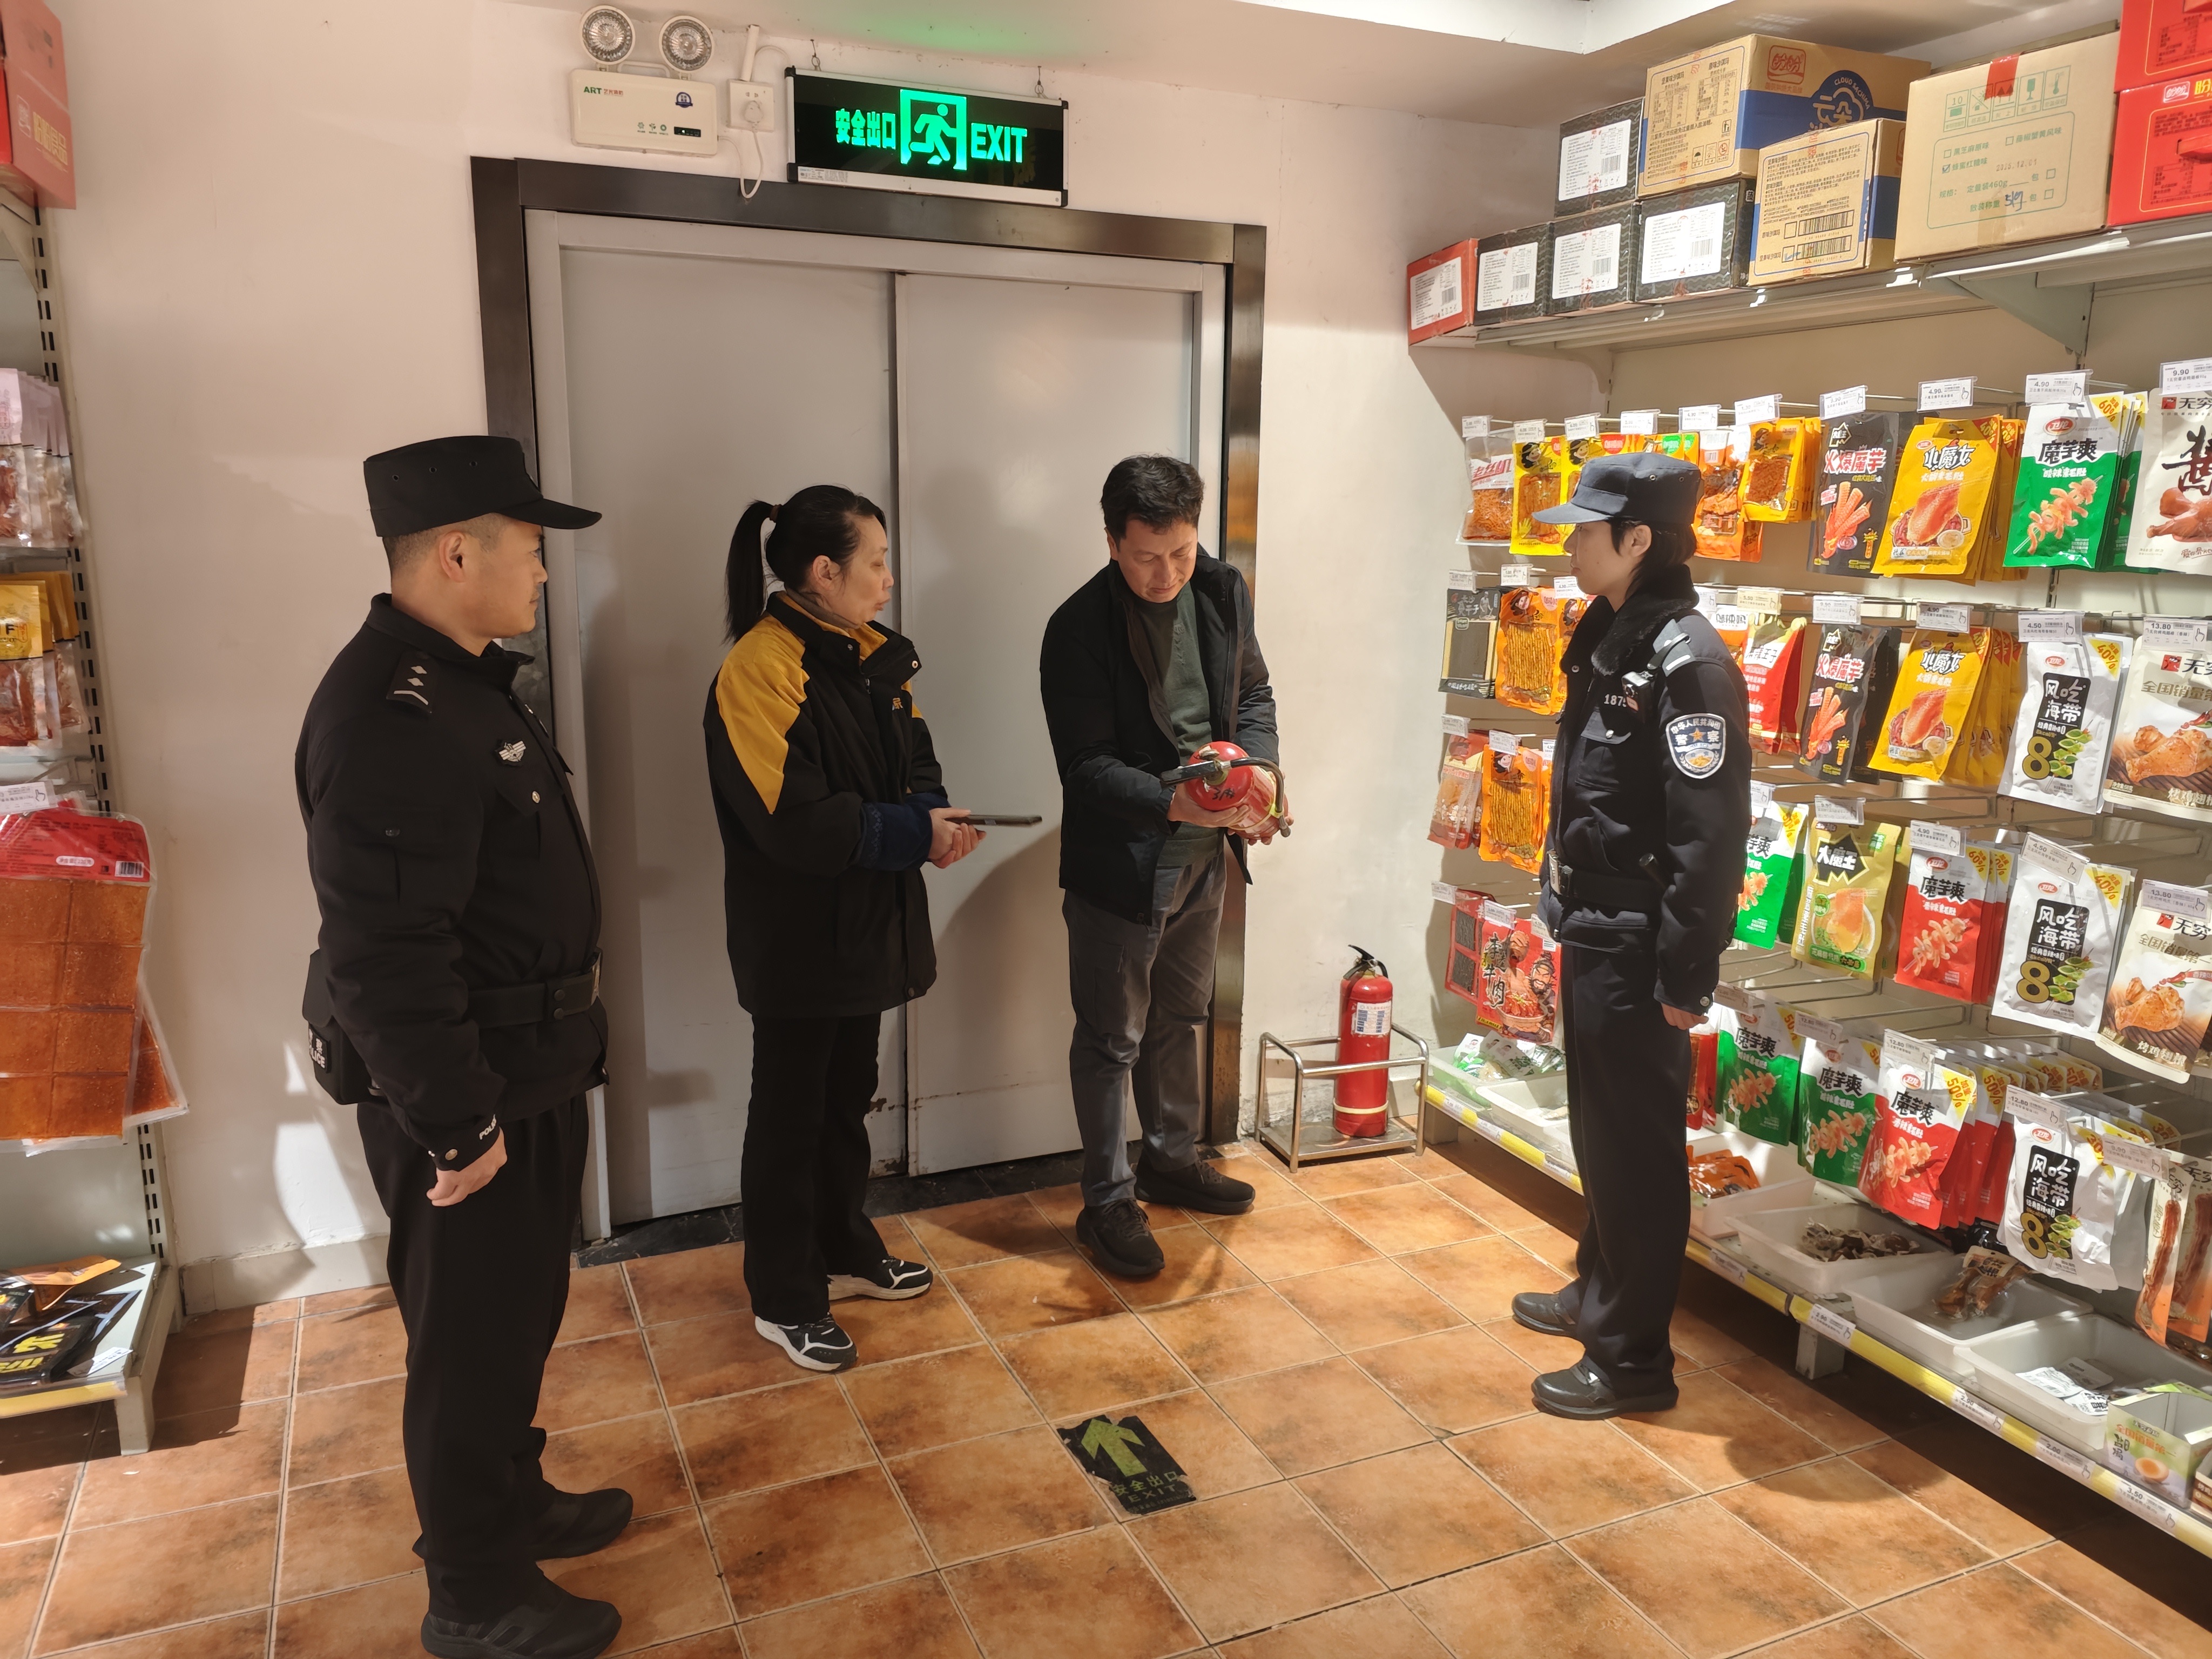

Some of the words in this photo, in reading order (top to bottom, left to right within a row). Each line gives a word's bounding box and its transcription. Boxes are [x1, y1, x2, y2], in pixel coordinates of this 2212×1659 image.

[583, 86, 602, 95] ART
[1834, 77, 1853, 85] CLOUD
[1852, 82, 1870, 110] SACHIMA
[1952, 96, 1963, 105] 10
[835, 108, 896, 150] 安全出口
[971, 123, 1027, 163] EXIT
[1953, 142, 1990, 156] 黑芝麻原味
[2099, 400, 2118, 422] 60%
[2179, 397, 2212, 409] 无穷
[1980, 421, 1997, 444] 40%
[1824, 448, 1887, 474] 火爆魔芋
[1923, 443, 1976, 471] 小魔女
[2038, 438, 2098, 464] 魔芋爽
[1816, 654, 1865, 683] 火爆魔芋
[1920, 648, 1966, 675] 小魔女
[2097, 642, 2119, 670] 40%
[2045, 679, 2086, 703] 风吃
[2045, 700, 2082, 723] 海带
[1670, 718, 1721, 734] 中华人民共和国
[1675, 733, 1689, 745] 警
[1707, 730, 1720, 743] 察
[2022, 736, 2052, 779] 8
[1746, 834, 1772, 858] 芋爽
[1817, 845, 1858, 871] 大魔王
[2033, 842, 2047, 853] 4.50
[1968, 851, 1986, 873] 60%
[1920, 875, 1967, 903] 魔芋爽
[2094, 874, 2117, 900] 40%
[2151, 889, 2171, 899] 13.80
[2036, 906, 2080, 931] 风吃
[2174, 918, 2211, 940] 无穷
[2038, 925, 2080, 951] 海带
[2138, 933, 2210, 964] 全国销量第一
[2016, 960, 2051, 1003] 8
[1735, 1027, 1777, 1058] 魔芋爽
[1890, 1039, 1905, 1048] 12.80
[2137, 1040, 2187, 1071] 烤鸡翅根
[309, 1047, 326, 1069] LICE
[1819, 1067, 1863, 1097] 魔芋爽
[1947, 1077, 1965, 1108] 50%
[1984, 1074, 2002, 1105] 50%
[1891, 1091, 1935, 1125] 魔芋爽
[2011, 1096, 2028, 1107] 12.80
[2031, 1154, 2076, 1183] 风吃
[2031, 1177, 2071, 1208] 海带
[2020, 1212, 2048, 1259] 8
[1960, 1395, 1974, 1406] 2.90
[1111, 1471, 1179, 1496] 安全出口
[1128, 1485, 1175, 1503] EXIT
[2126, 1487, 2143, 1498] 3.50
